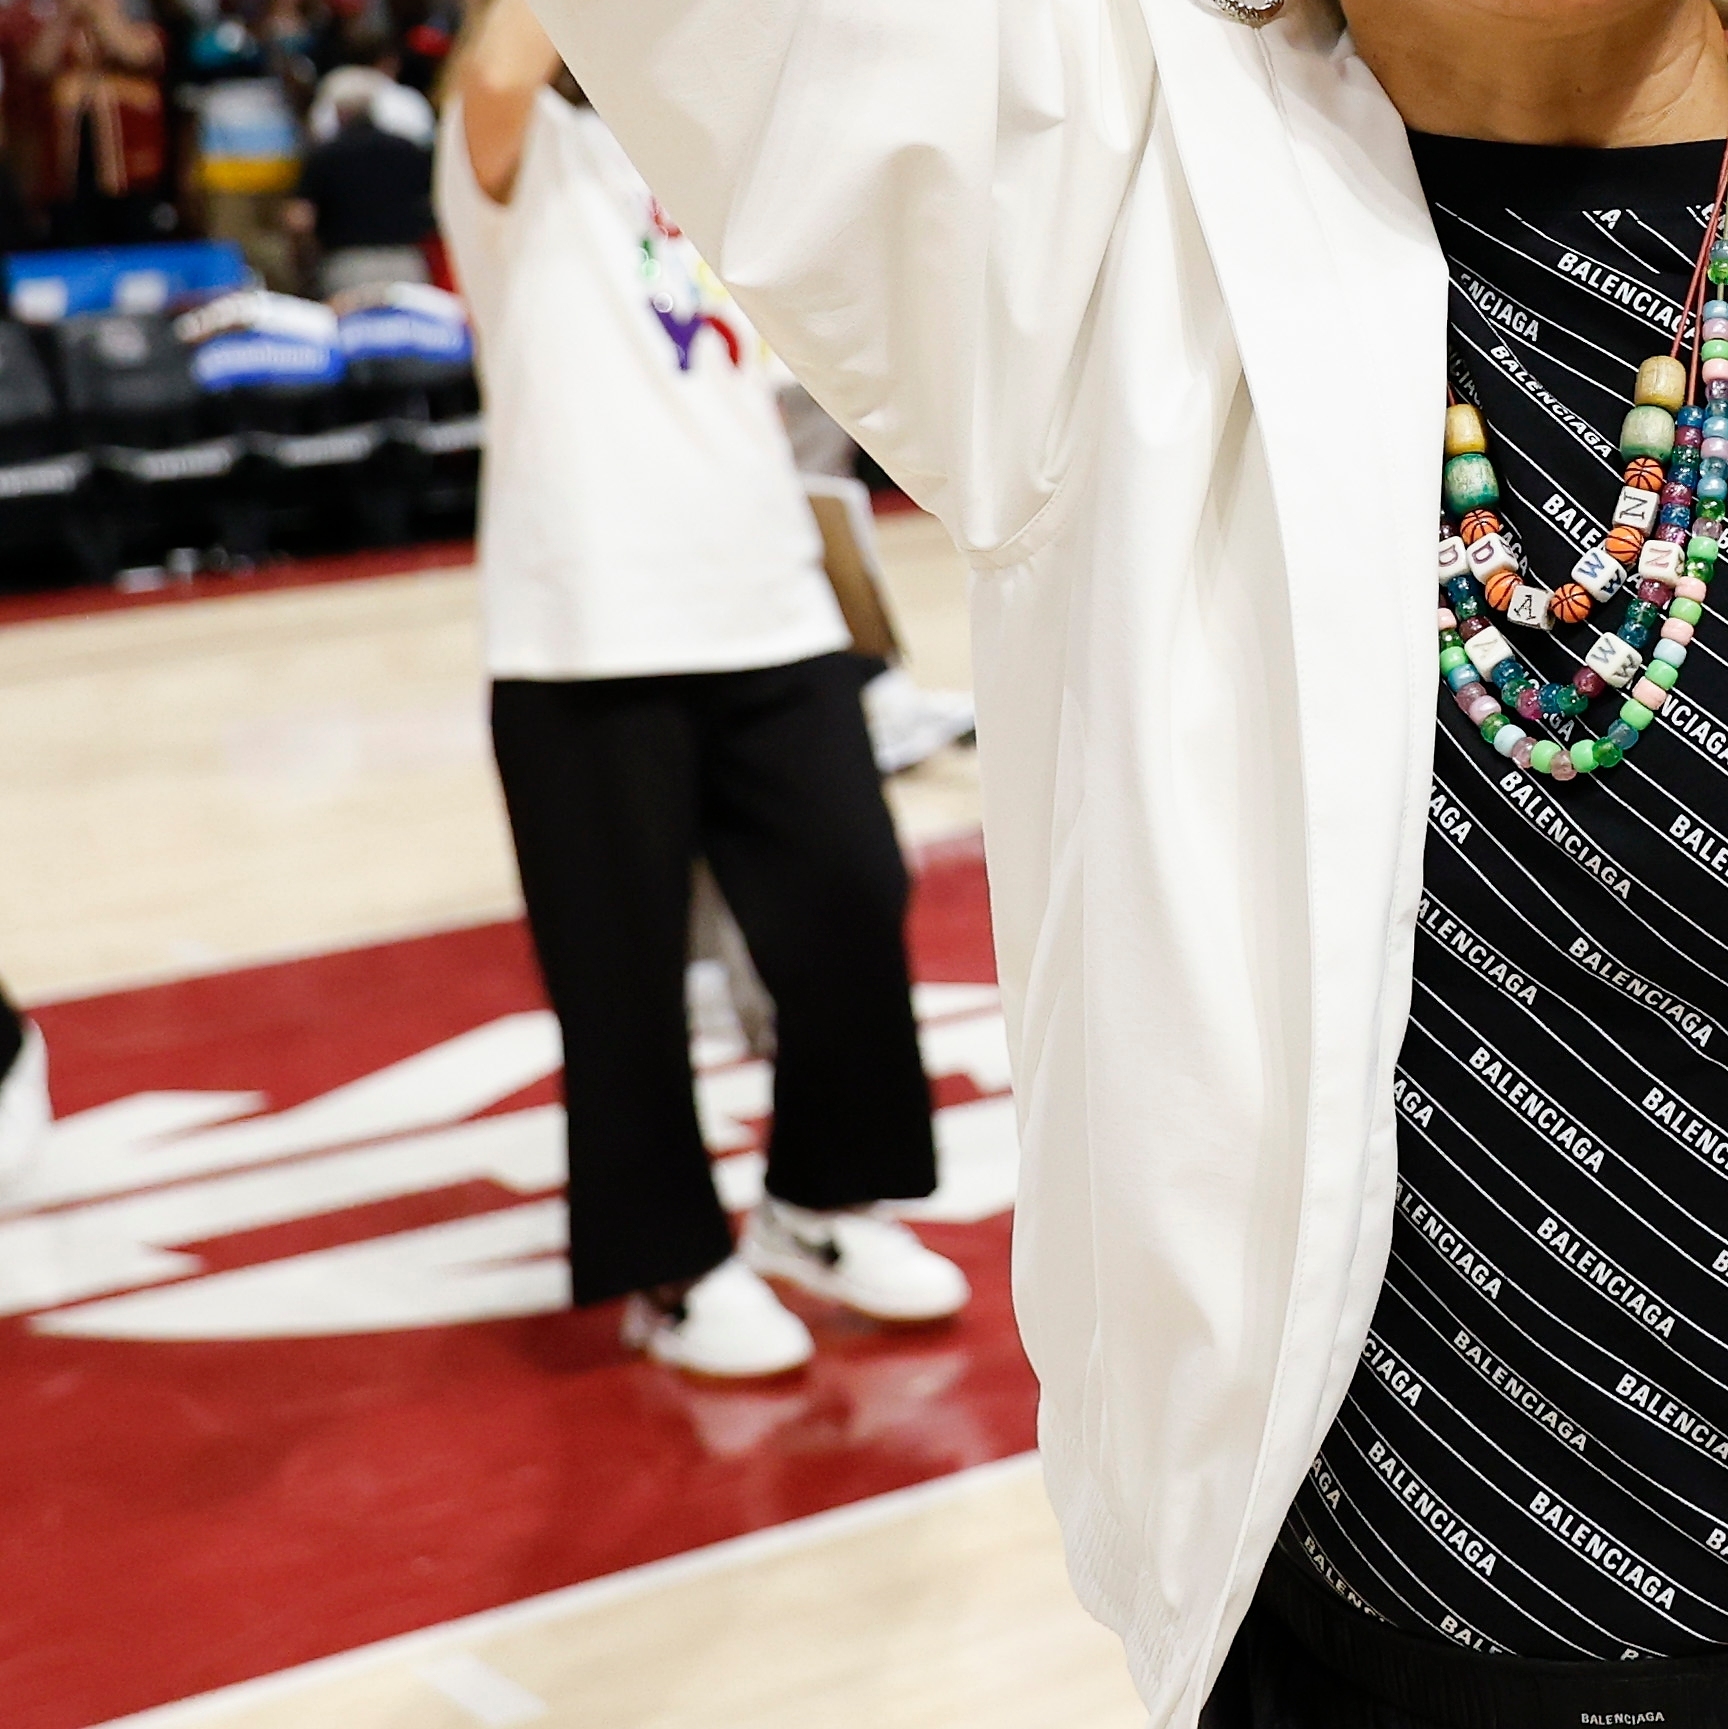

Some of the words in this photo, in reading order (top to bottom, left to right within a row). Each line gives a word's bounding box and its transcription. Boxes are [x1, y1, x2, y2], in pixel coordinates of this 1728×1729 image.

[1490, 345, 1613, 458] BALENCIAGA
[1499, 771, 1632, 901] BALENCIAGA
[1416, 897, 1539, 1006] ALENCIAGA
[1568, 936, 1714, 1048] BALENCIAGA
[1468, 1046, 1606, 1174] BALENCIAGA
[1536, 1217, 1677, 1339] BALENCIAGA
[1453, 1330, 1588, 1452] BALENCIAGA
[1367, 1440, 1497, 1577] BALENCIAGA
[1528, 1490, 1676, 1612] BALENCIAGA
[1580, 1711, 1665, 1726] BALENCIAGA
